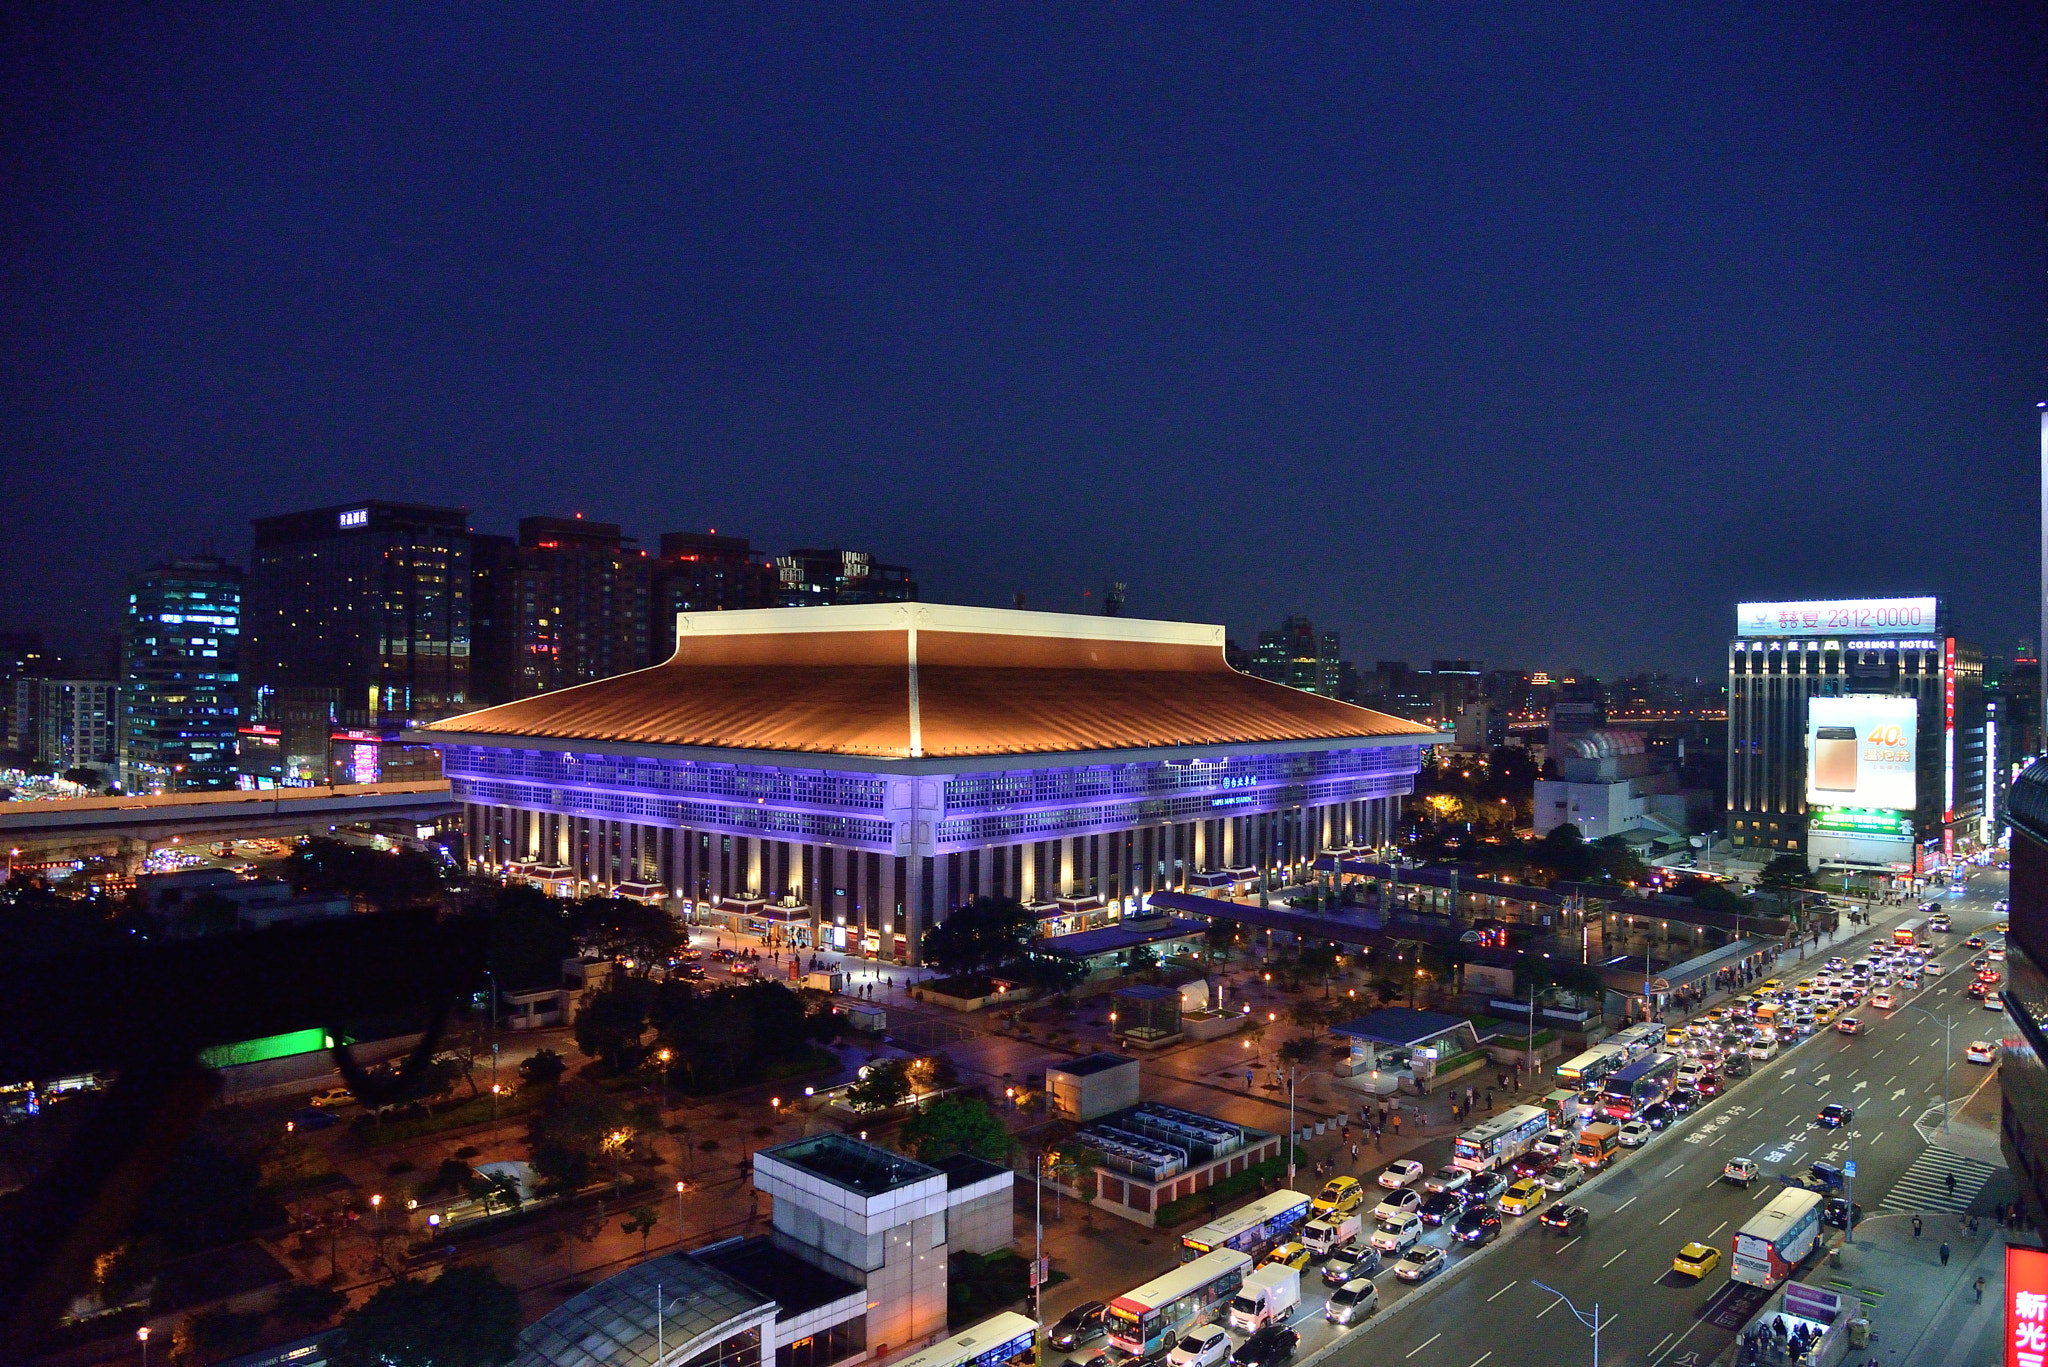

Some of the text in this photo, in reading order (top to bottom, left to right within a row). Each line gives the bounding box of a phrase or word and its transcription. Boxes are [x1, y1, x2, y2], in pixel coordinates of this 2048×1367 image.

[1828, 606, 1921, 628] 2312-0000
[1848, 641, 1896, 649] COSMOS
[1899, 639, 1936, 649] HOTEL
[1231, 775, 1257, 788] 台北車站
[1211, 798, 1224, 806] TAIPEI
[1224, 797, 1235, 805] MAIN
[1763, 1121, 1821, 1163] 中山北路
